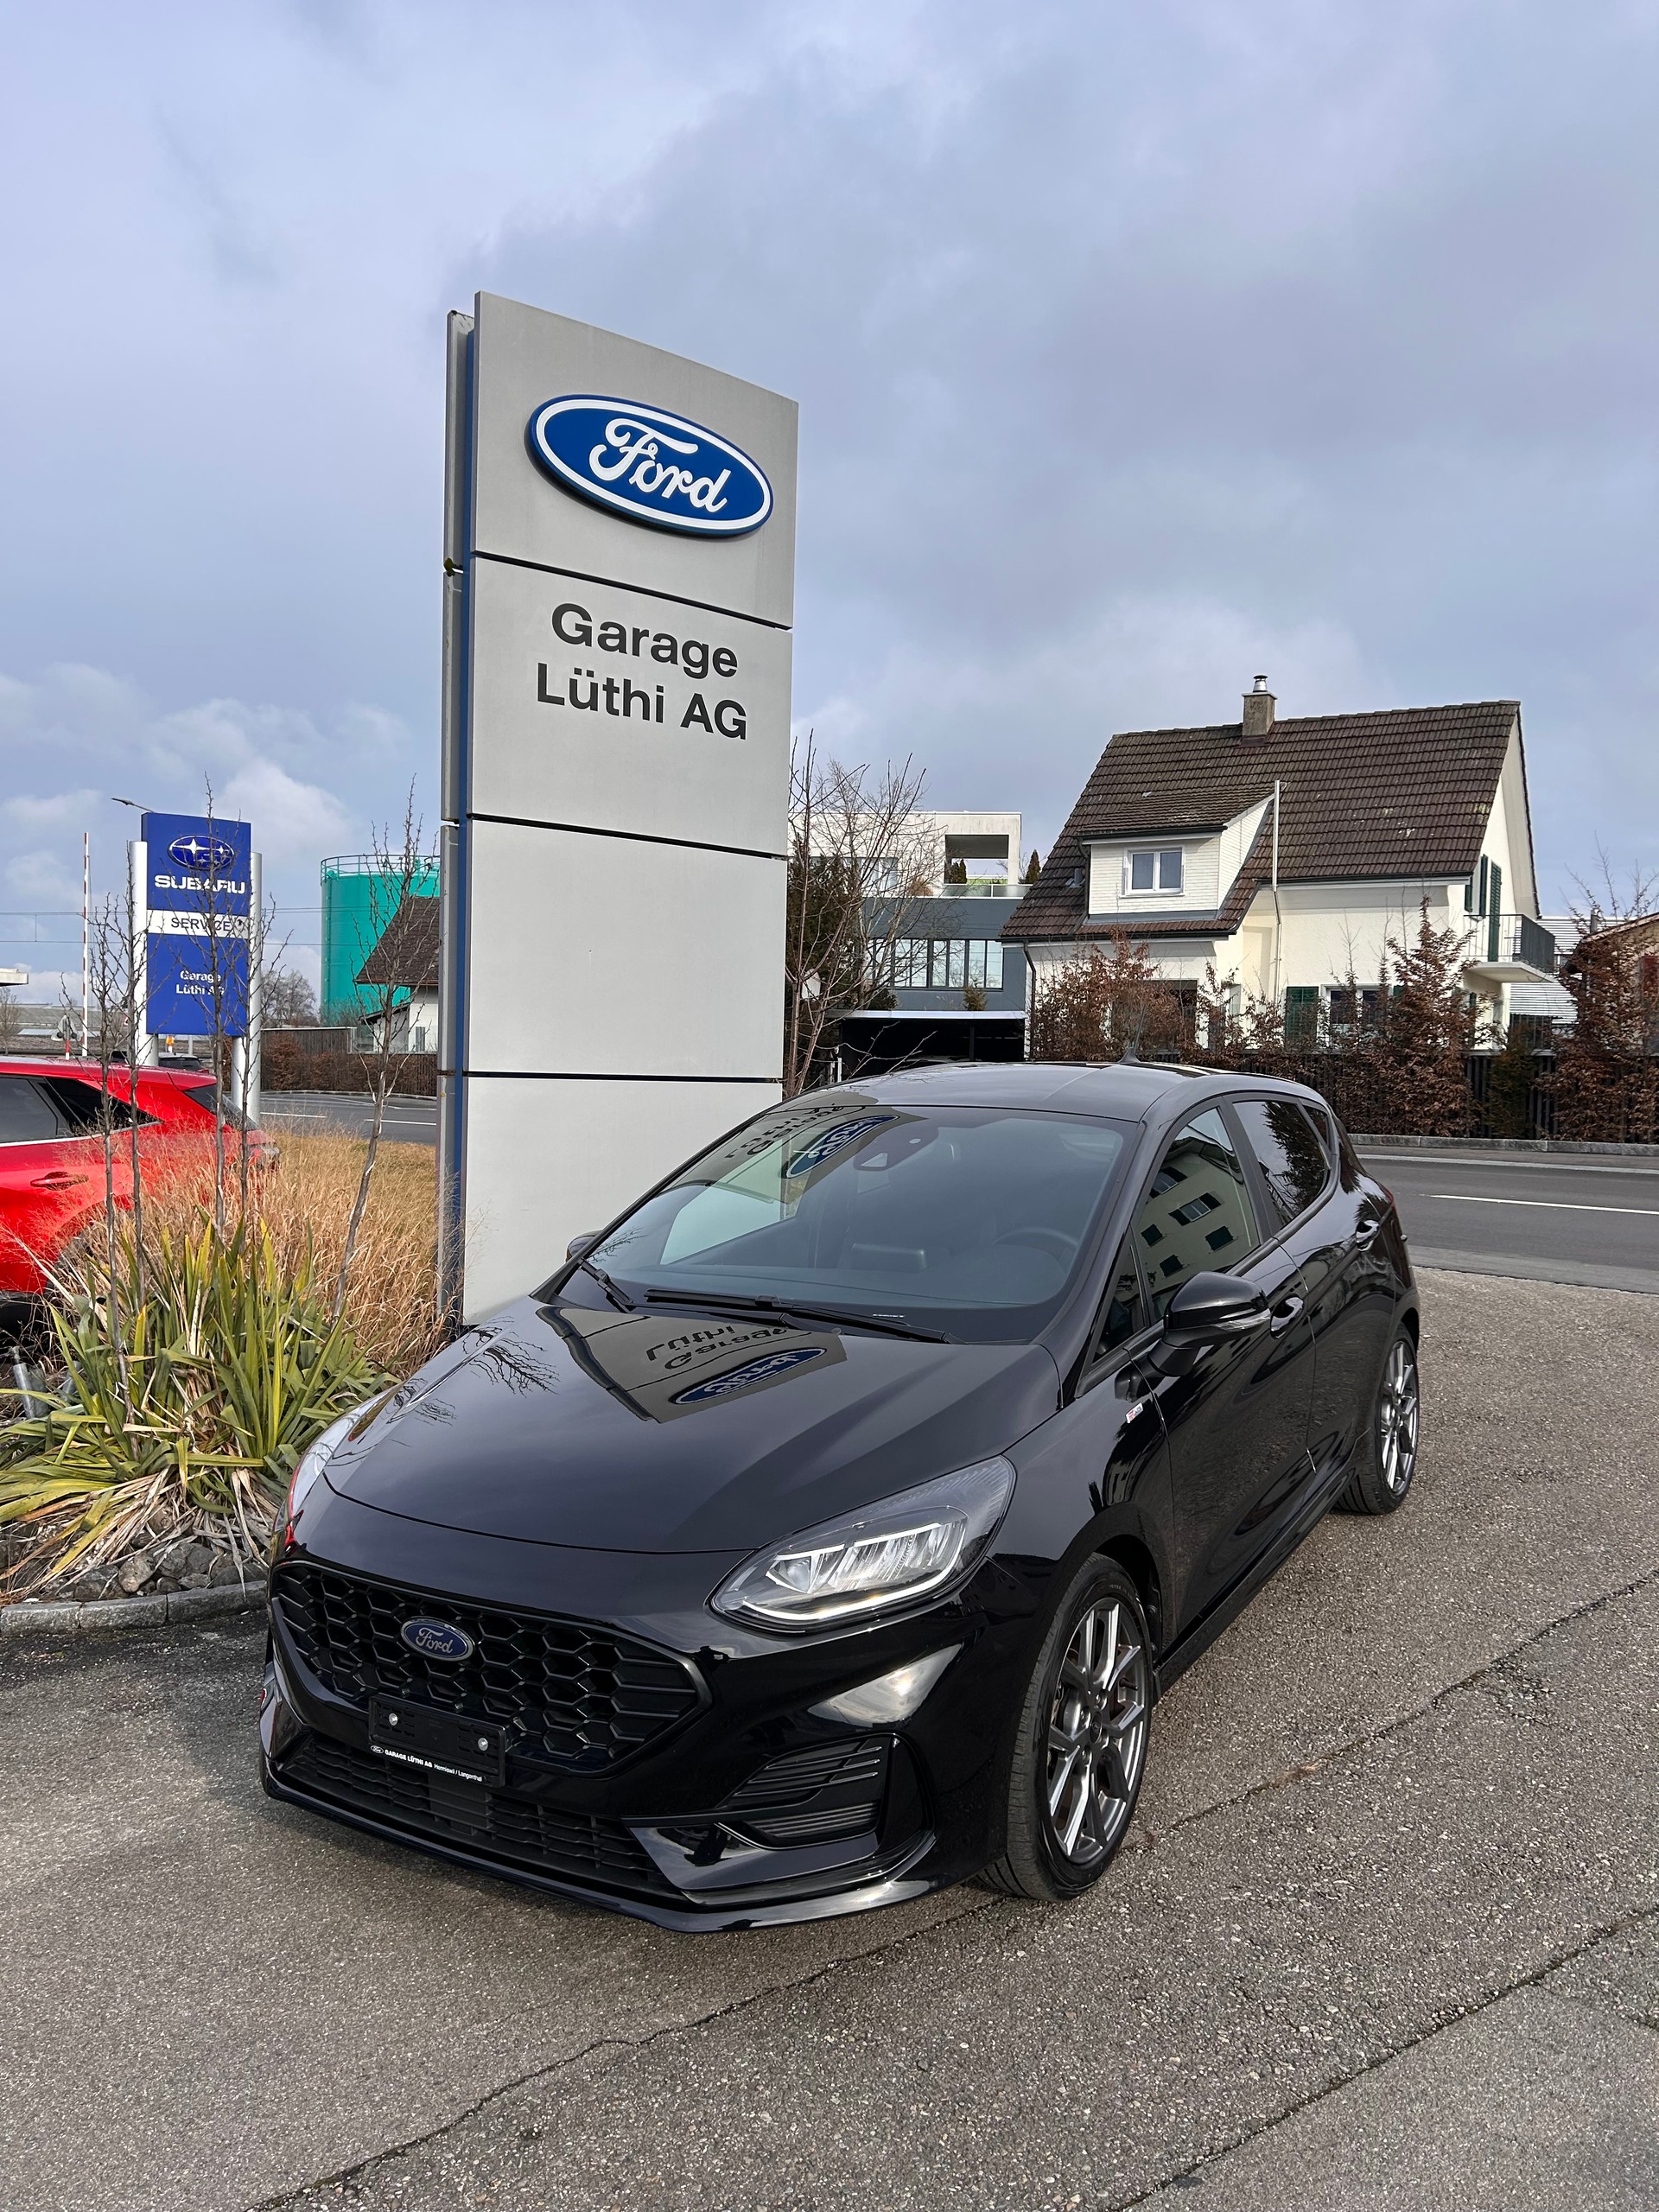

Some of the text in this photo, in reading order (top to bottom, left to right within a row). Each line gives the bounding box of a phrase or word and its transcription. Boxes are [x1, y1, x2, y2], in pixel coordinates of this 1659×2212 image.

[588, 418, 732, 513] Ford
[550, 603, 739, 680] Garage
[537, 662, 748, 741] Lüthi AG
[154, 874, 246, 894] SUBARU
[180, 969, 221, 983] Garage
[175, 983, 206, 995] Lüthi
[415, 1627, 454, 1655] Ford
[384, 1749, 407, 1761] GARAGE
[407, 1755, 424, 1765] LÜTHI
